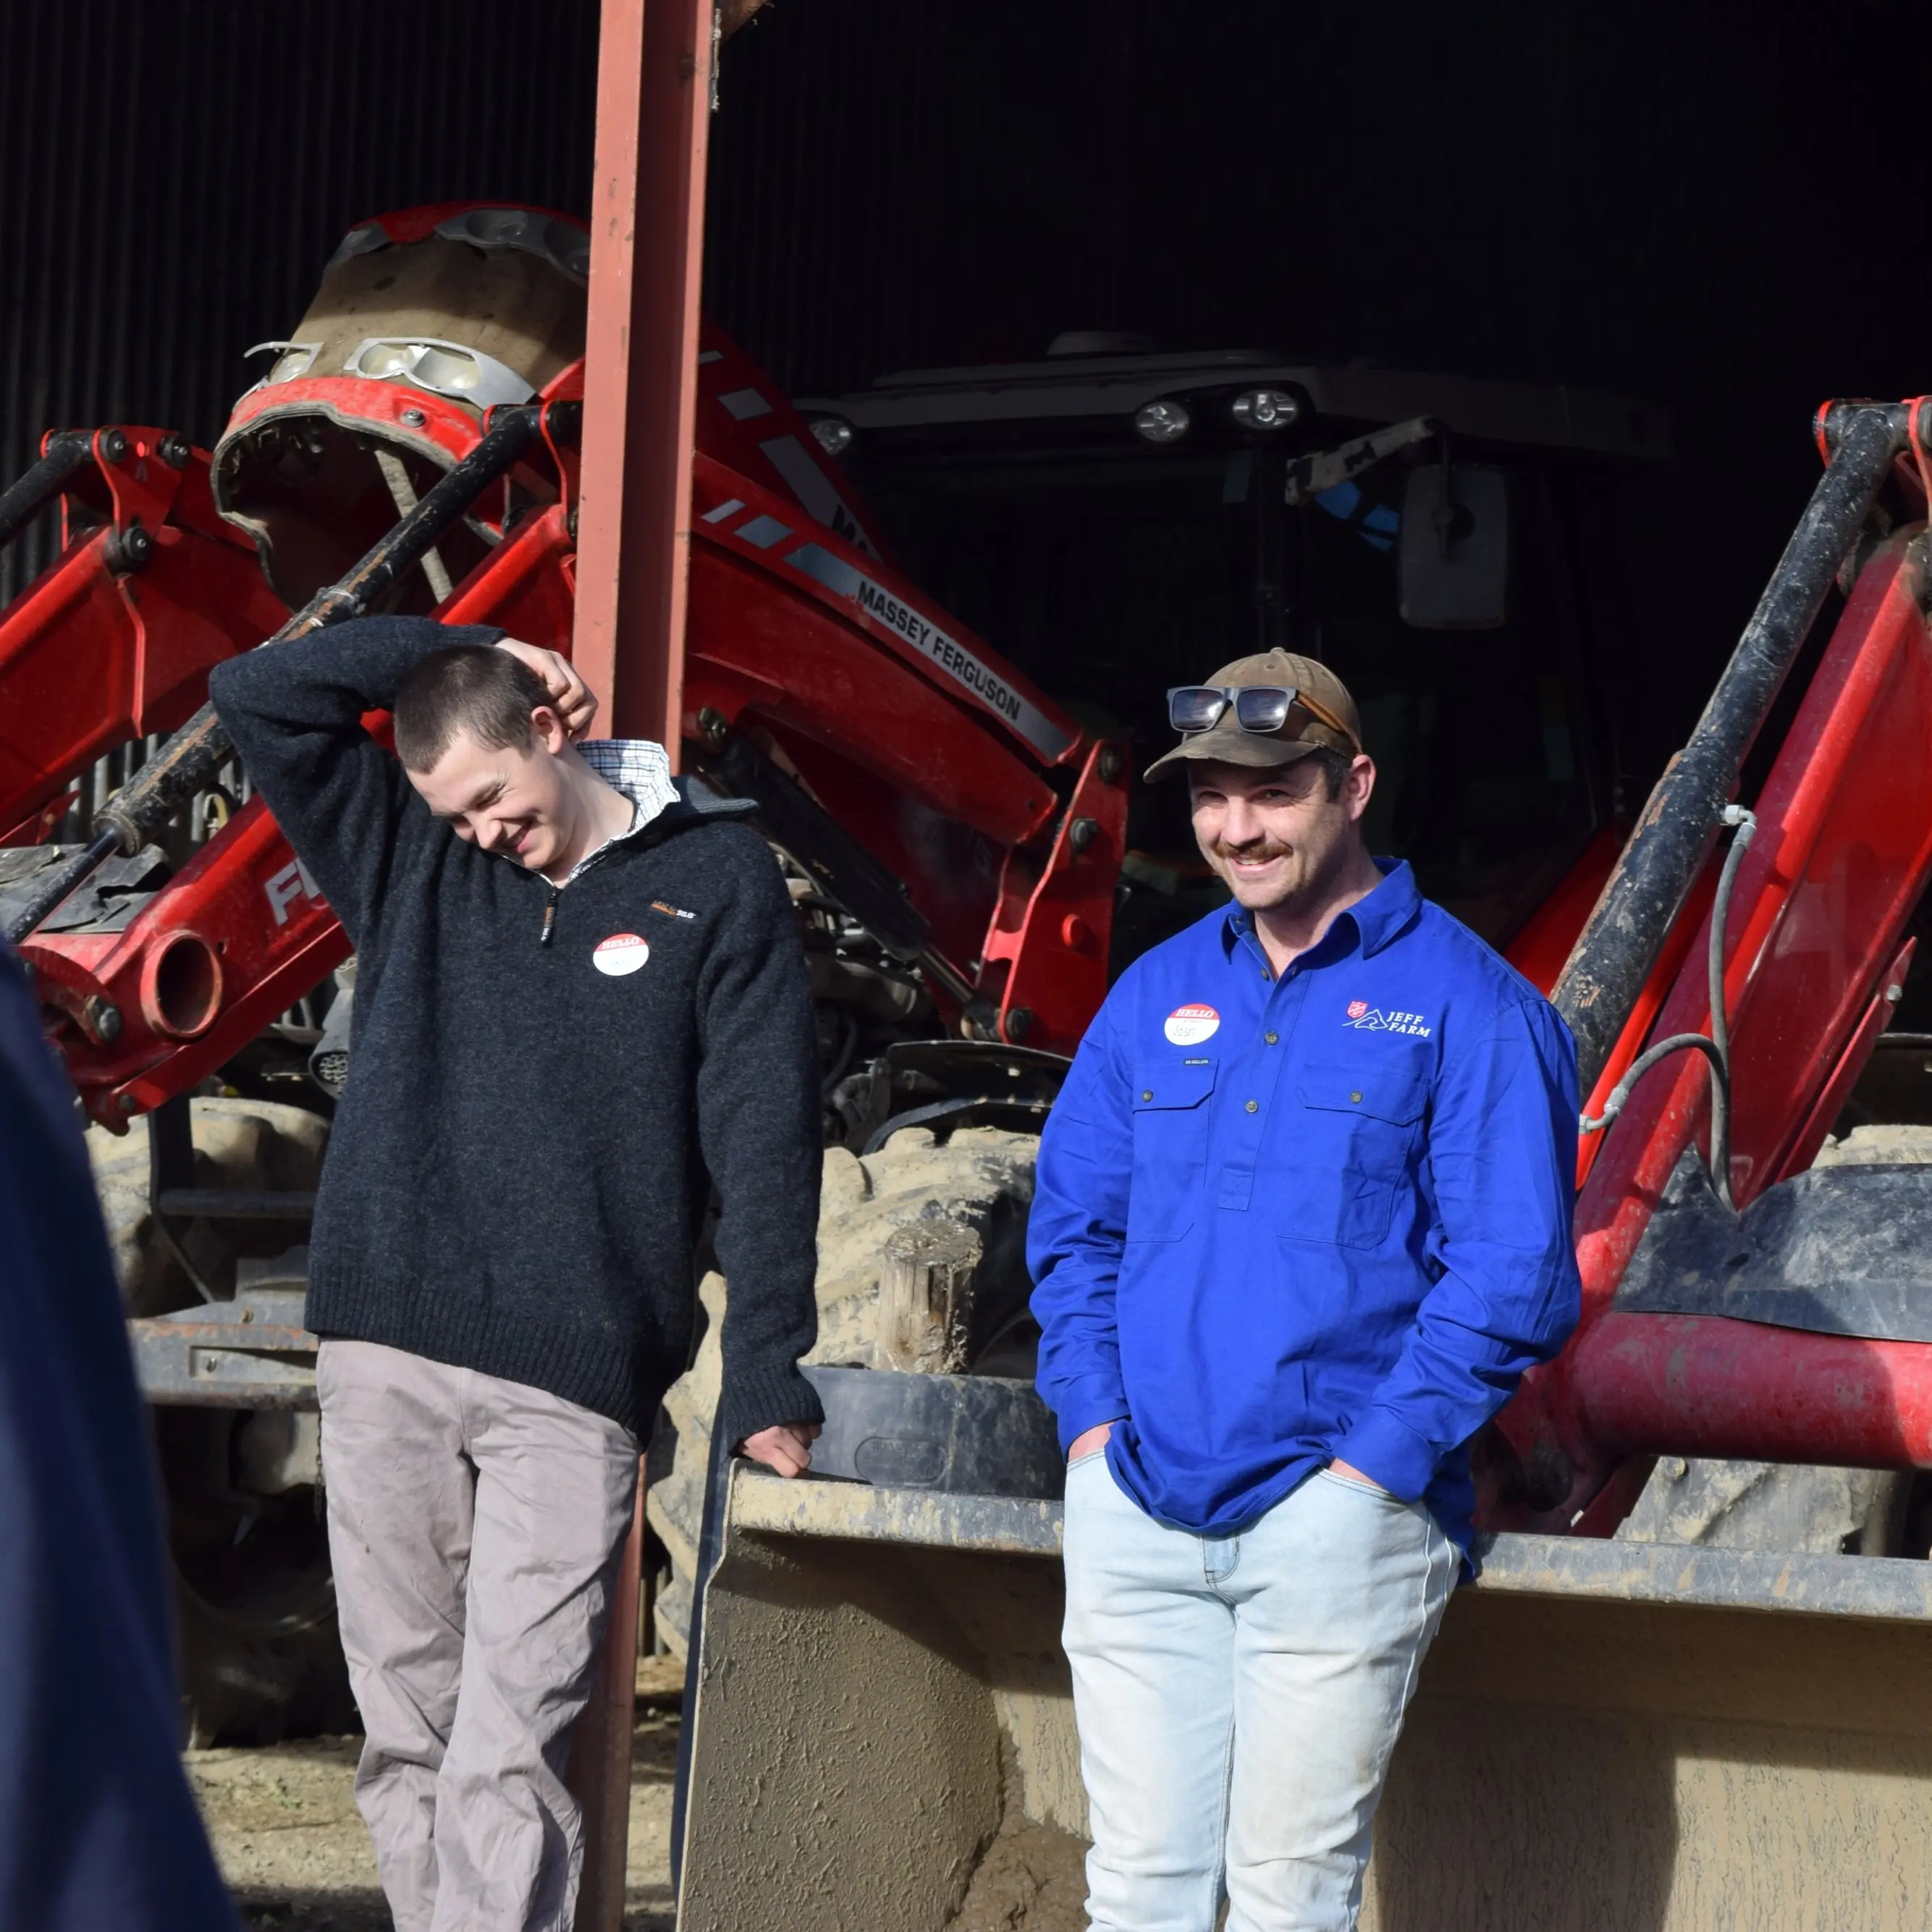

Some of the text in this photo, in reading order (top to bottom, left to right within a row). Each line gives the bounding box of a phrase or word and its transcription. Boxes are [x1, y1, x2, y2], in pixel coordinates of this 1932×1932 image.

[857, 579, 1022, 722] MASSEY FERGUSON
[600, 935, 640, 949] HELLO
[1174, 1009, 1214, 1018] HELLO
[1386, 1011, 1424, 1025] JEFF
[1388, 1022, 1432, 1038] FARM
